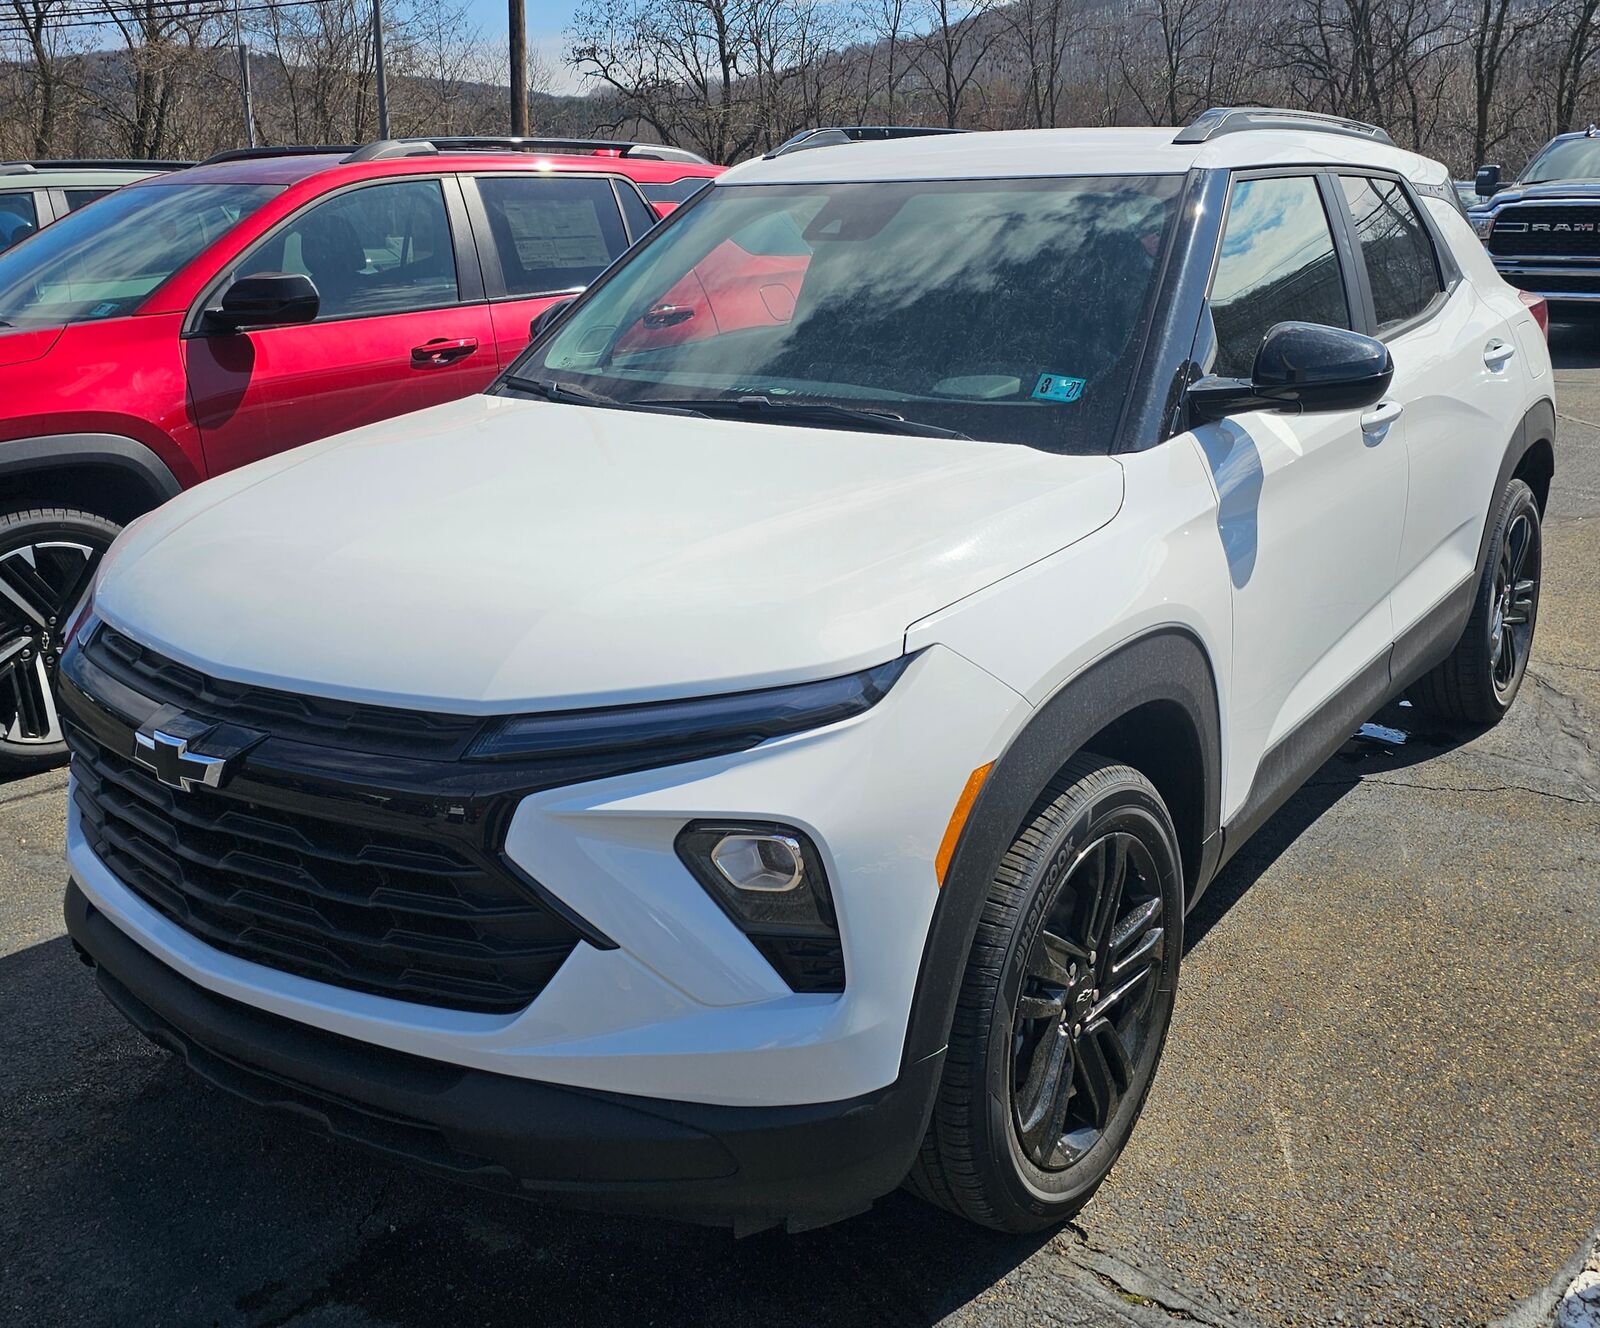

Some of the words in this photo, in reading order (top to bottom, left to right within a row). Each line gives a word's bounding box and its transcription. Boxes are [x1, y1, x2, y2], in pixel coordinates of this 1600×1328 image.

[1532, 223, 1594, 232] RAM
[1040, 377, 1052, 394] 3
[1065, 381, 1081, 398] 27
